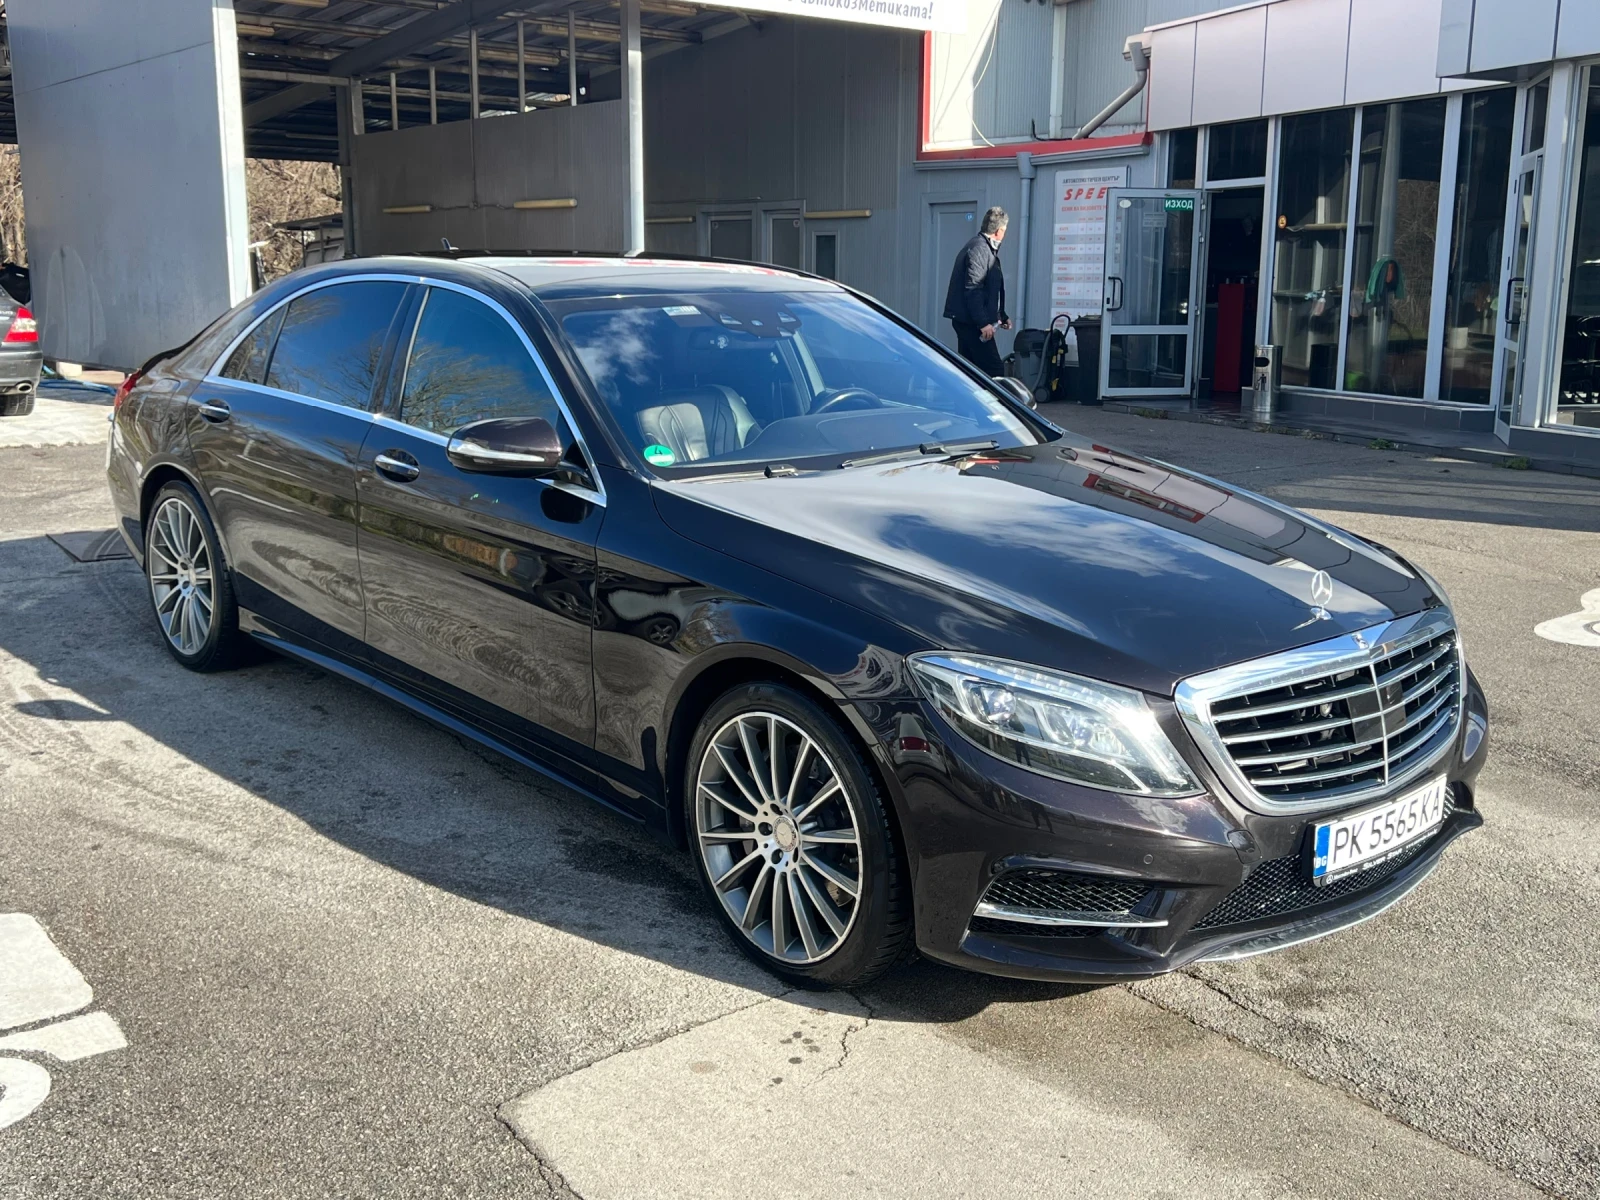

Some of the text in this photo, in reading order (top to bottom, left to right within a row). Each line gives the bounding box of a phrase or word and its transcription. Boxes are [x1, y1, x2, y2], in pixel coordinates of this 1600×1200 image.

[1165, 199, 1193, 210] ИЗХОД
[654, 446, 663, 455] 4
[1332, 820, 1366, 864] PK
[1369, 799, 1419, 850] 5565
[1419, 786, 1441, 827] KA
[1315, 855, 1327, 869] BG
